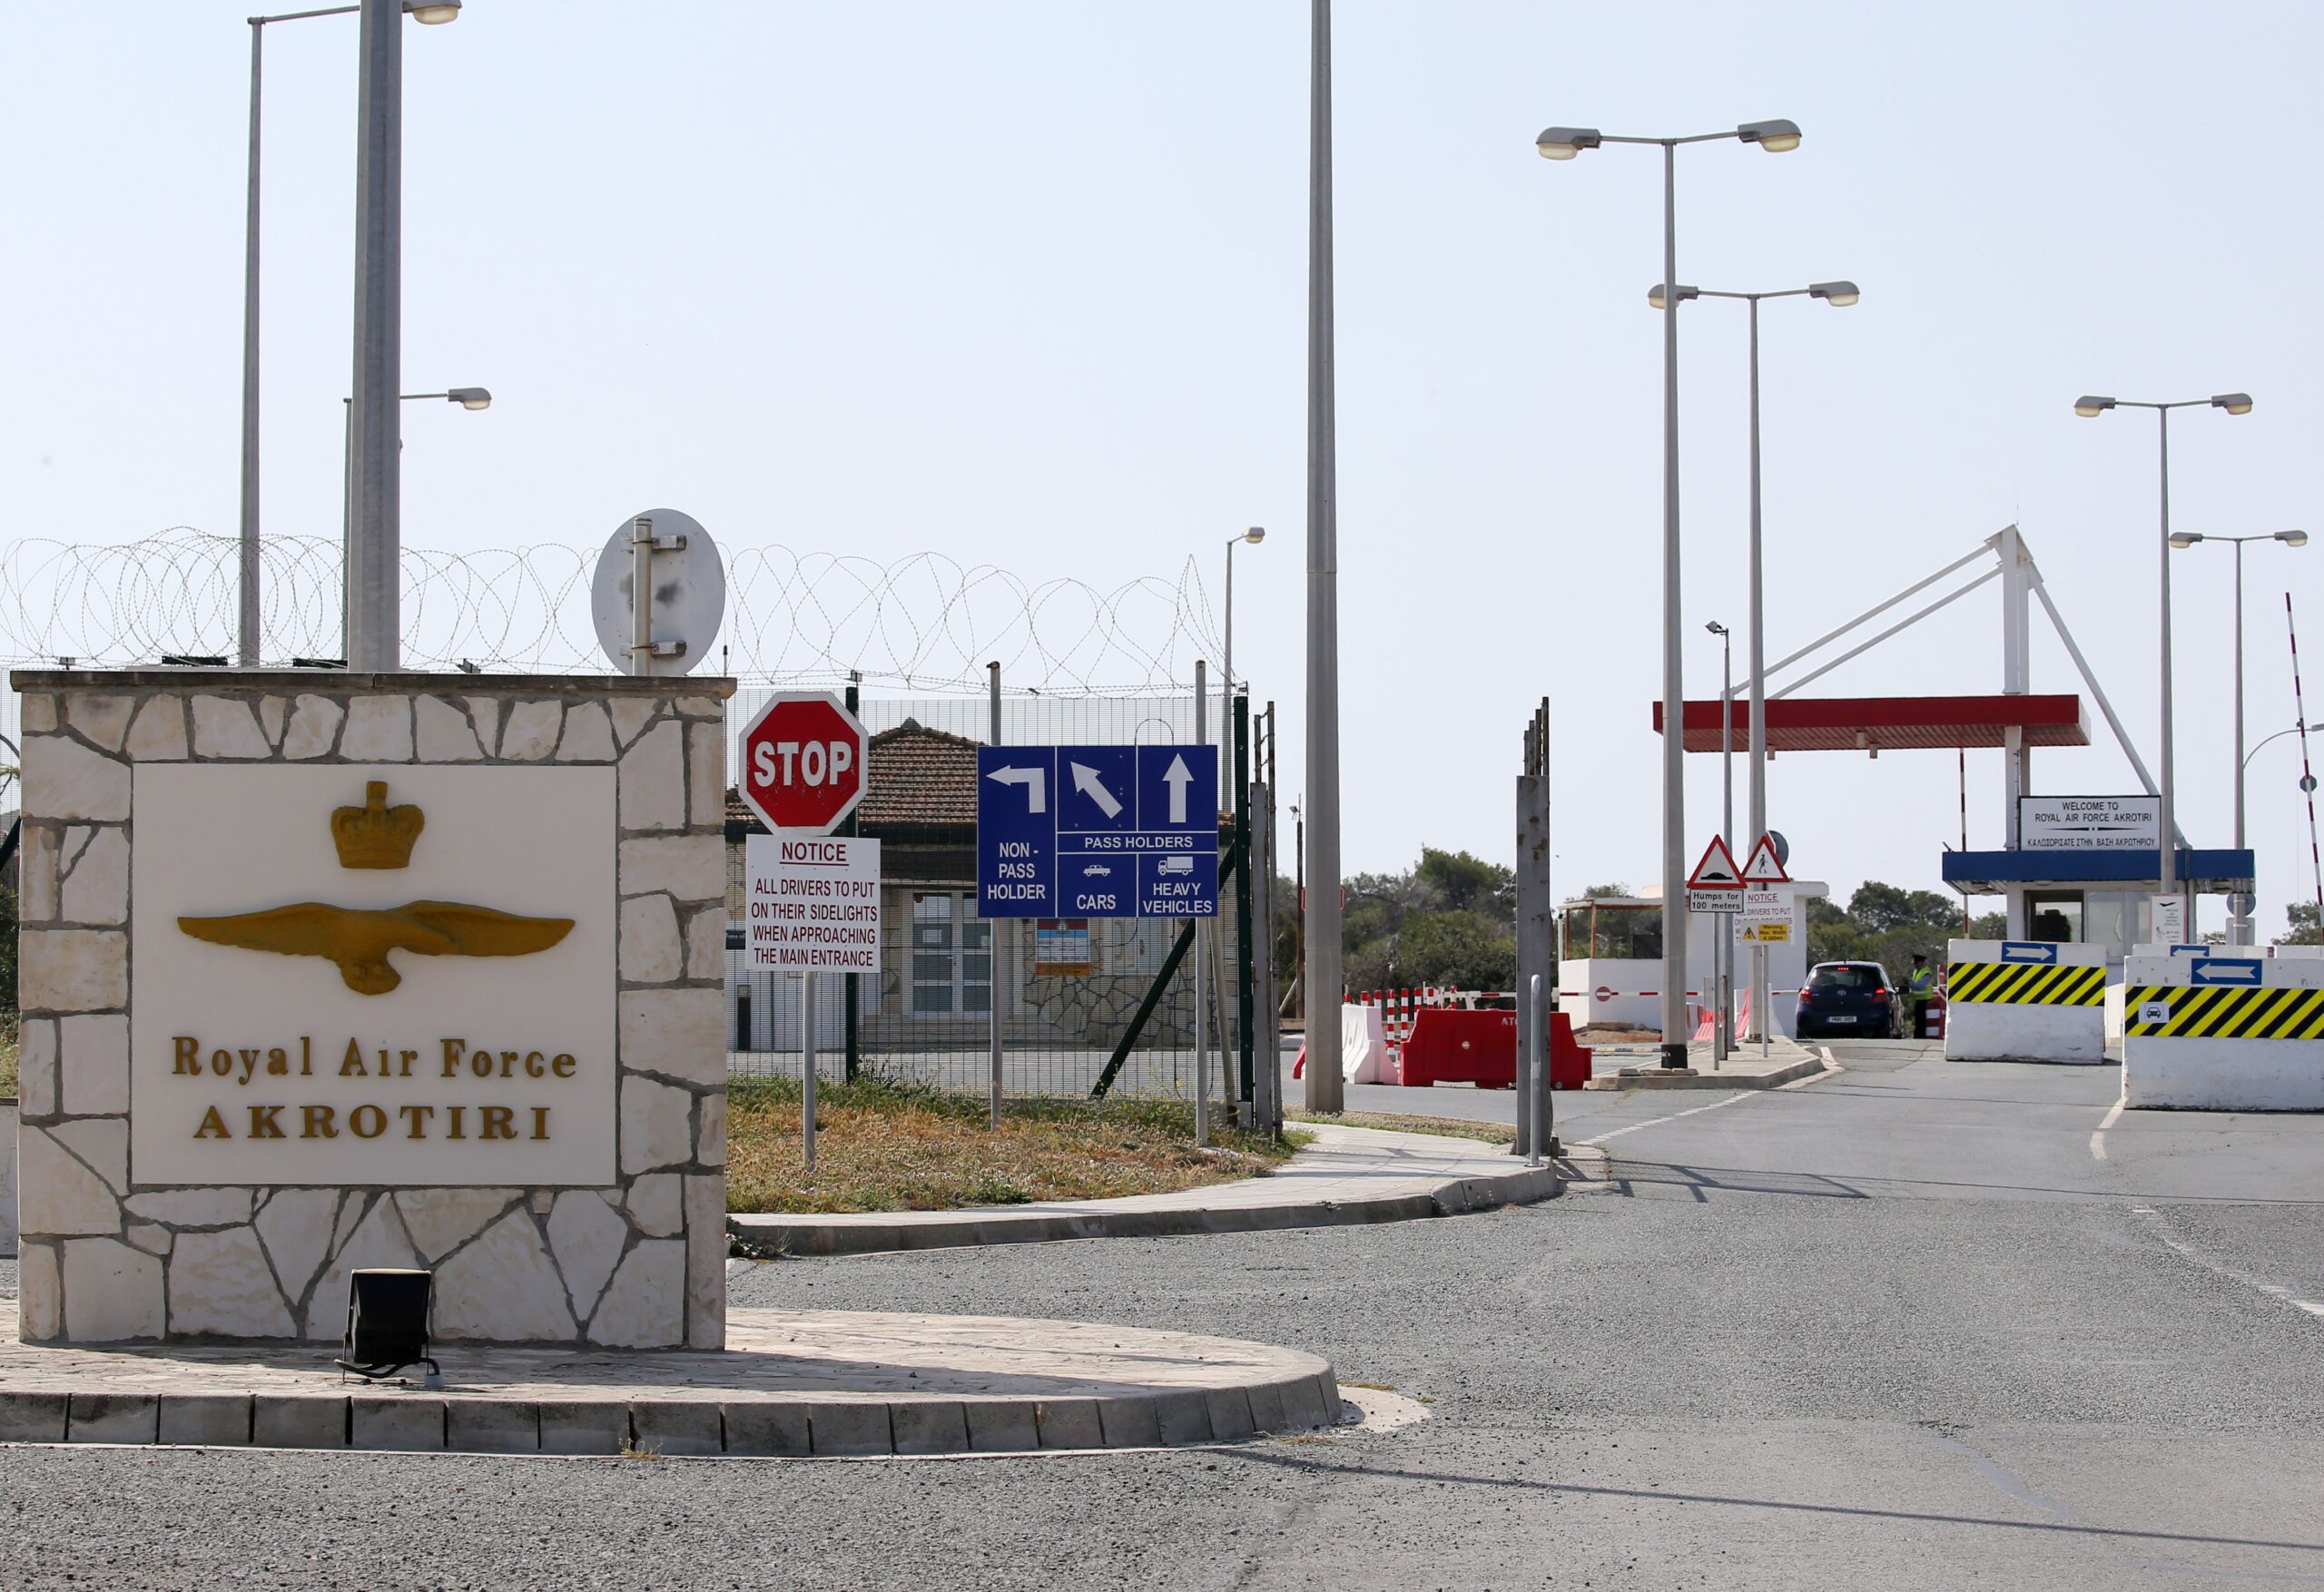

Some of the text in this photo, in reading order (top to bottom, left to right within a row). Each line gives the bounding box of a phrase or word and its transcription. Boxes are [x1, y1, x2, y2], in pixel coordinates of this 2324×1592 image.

[753, 740, 852, 788] STOP
[2063, 801, 2119, 811] WELCOME TO
[2034, 813, 2152, 822] ROYAL AIR FORCE AKROTIRI
[1085, 836, 1193, 848] PASS HOLDERS
[2076, 838, 2093, 846] ΣΤΗΝ
[2096, 838, 2113, 846] ΒΑΣΗ
[782, 841, 846, 861] NOTICE
[1000, 842, 1029, 858] NON
[999, 863, 1035, 879] PASS
[755, 878, 875, 898] ALL DRIVERS TO PUT
[988, 884, 1046, 899] HOLDER
[1153, 882, 1201, 896] HEAVY
[1077, 894, 1117, 909] CARS
[1693, 892, 1739, 900] Humps for
[1748, 893, 1778, 902] NOTICE
[752, 901, 878, 921] ON THEIR SIDELIGHTS
[1143, 900, 1212, 914] VEHICLES
[1692, 901, 1740, 909] 100 meters
[753, 925, 875, 944] WHEN APPROACHING
[754, 948, 873, 967] THE MAIN ENTRANCE
[172, 1036, 576, 1086] Royal Air Force
[192, 1105, 551, 1140] AKROTIRI
